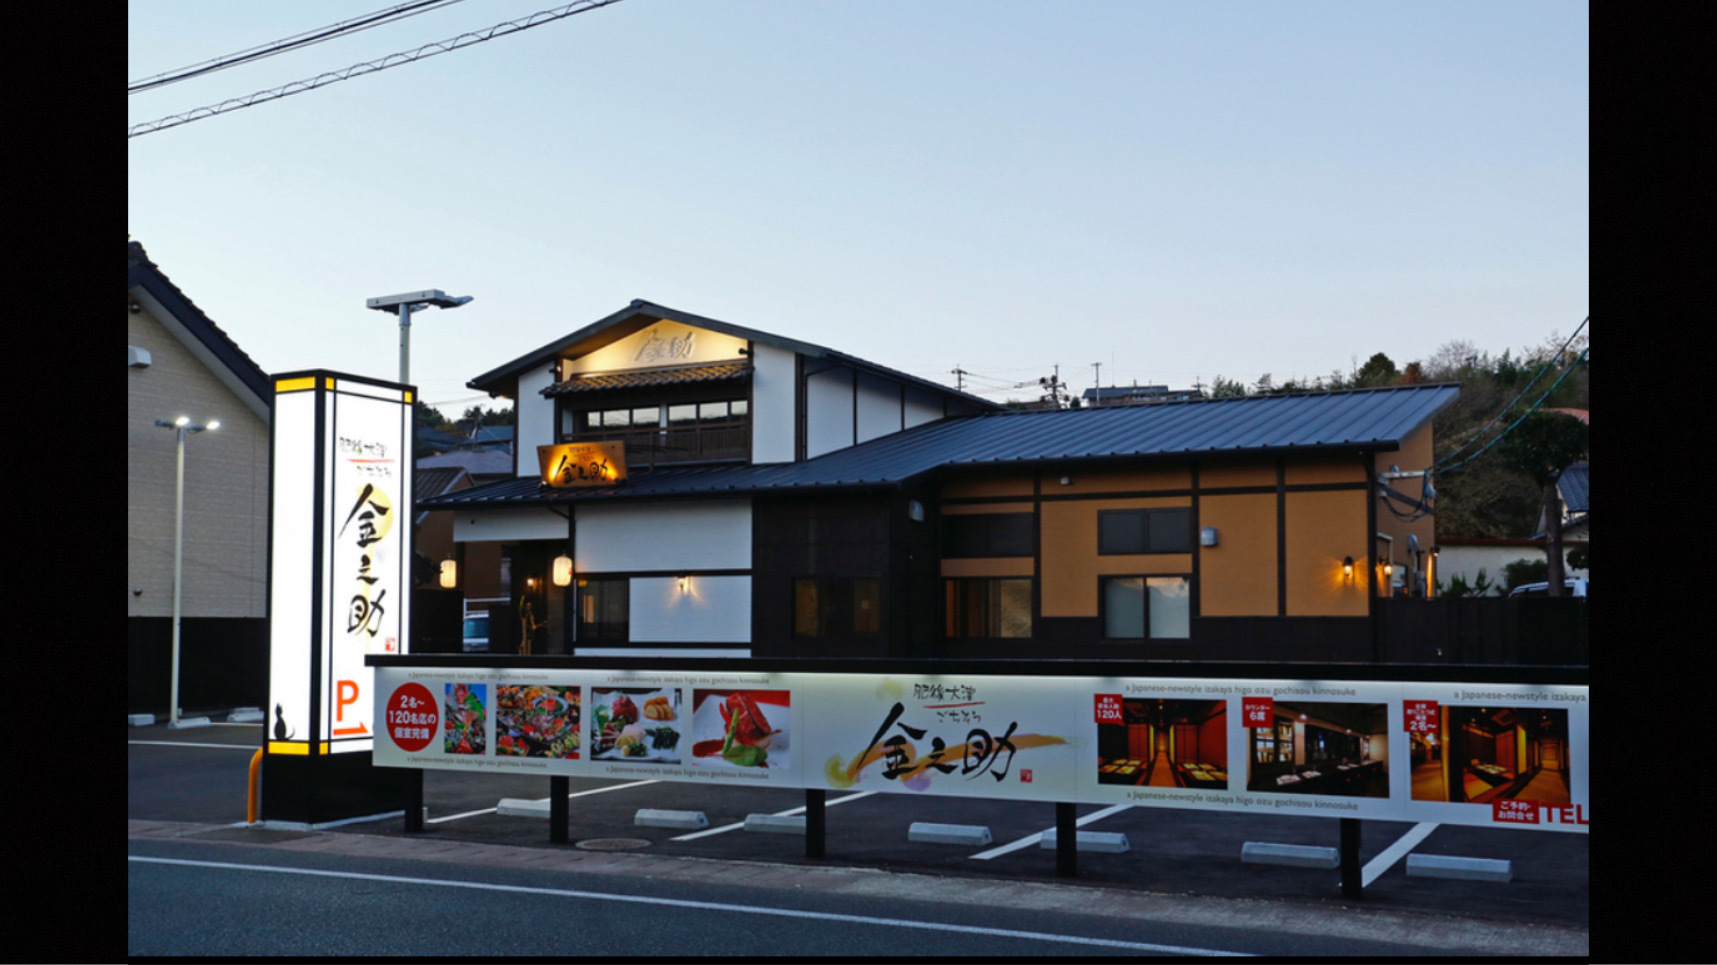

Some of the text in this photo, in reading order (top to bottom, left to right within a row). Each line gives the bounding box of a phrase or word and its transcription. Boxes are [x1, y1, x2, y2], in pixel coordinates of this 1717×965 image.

[553, 454, 608, 484] 金之助
[337, 483, 390, 638] 金之助
[336, 680, 359, 722] P
[1097, 709, 1122, 719] 120人
[856, 701, 1018, 782] 金之助
[1498, 810, 1535, 821] お問合せ
[1540, 803, 1589, 825] TEL
